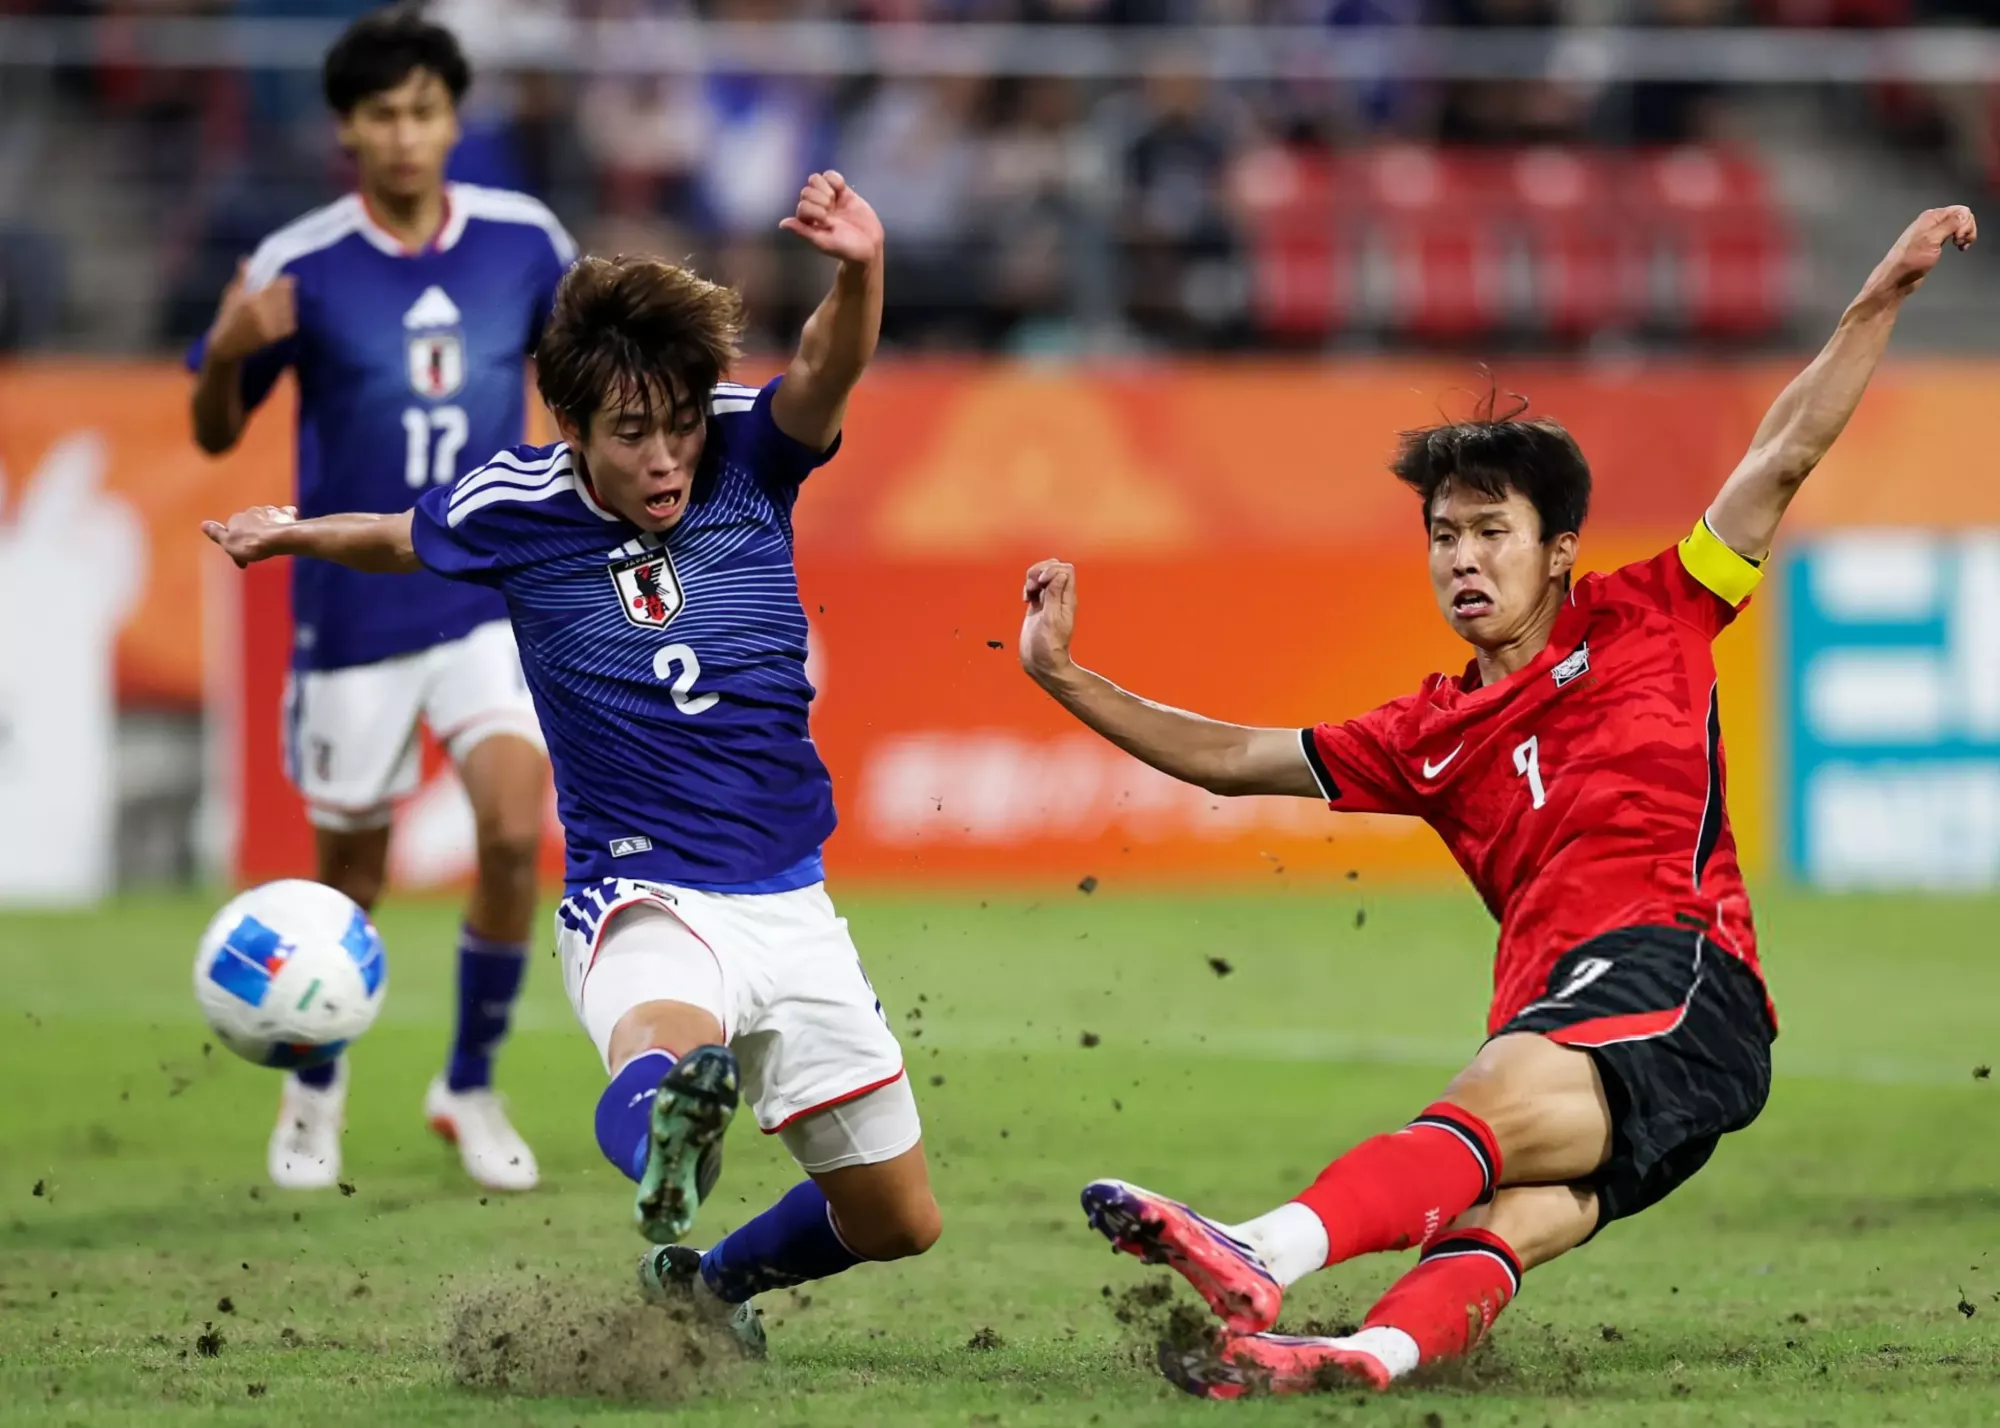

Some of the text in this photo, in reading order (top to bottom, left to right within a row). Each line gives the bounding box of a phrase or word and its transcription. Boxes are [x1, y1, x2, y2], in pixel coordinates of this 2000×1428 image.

[402, 404, 468, 488] 17
[624, 553, 654, 568] JAPAN
[652, 643, 720, 715] 2
[1512, 734, 1546, 810] 7
